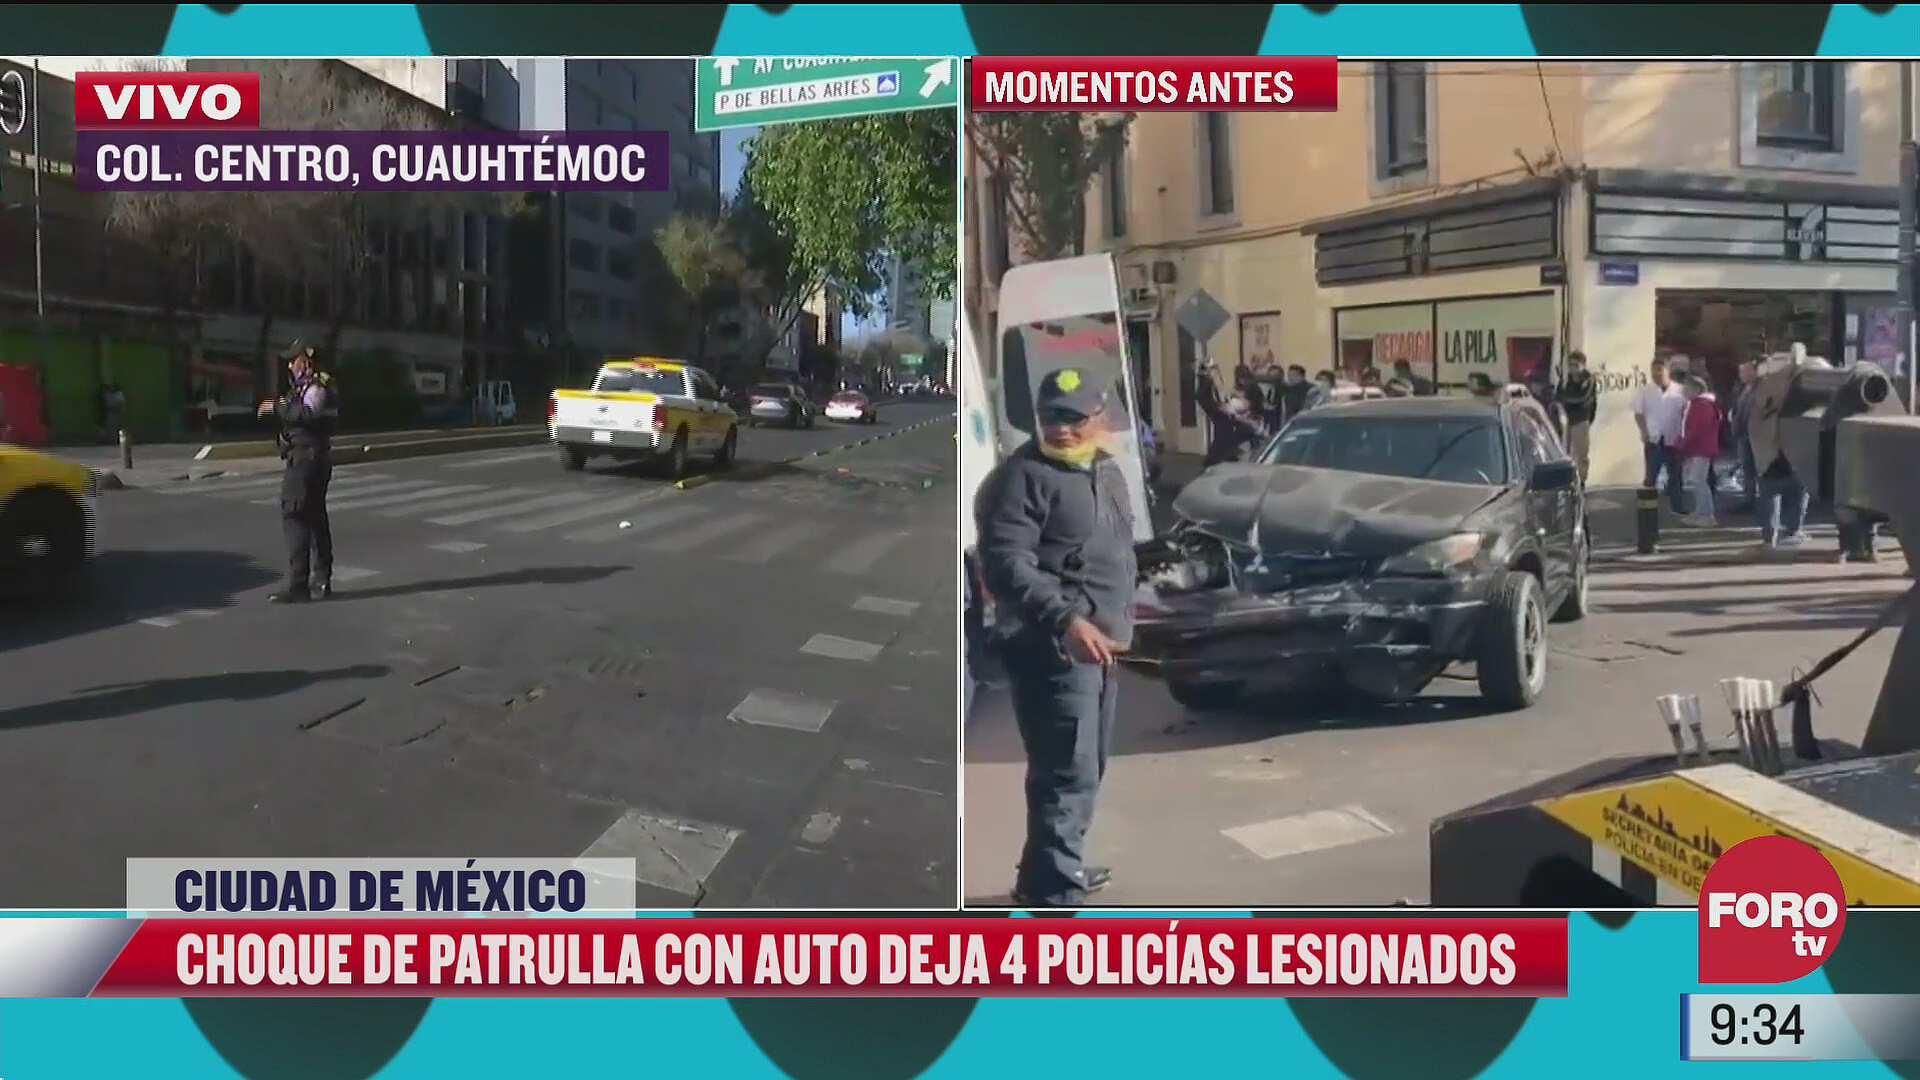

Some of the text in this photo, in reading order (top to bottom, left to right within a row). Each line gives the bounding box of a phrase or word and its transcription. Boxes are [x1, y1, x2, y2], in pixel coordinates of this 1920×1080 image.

[721, 79, 871, 110] P DE BELLAS ARTES
[1444, 329, 1462, 363] LA
[1465, 328, 1498, 363] PILA
